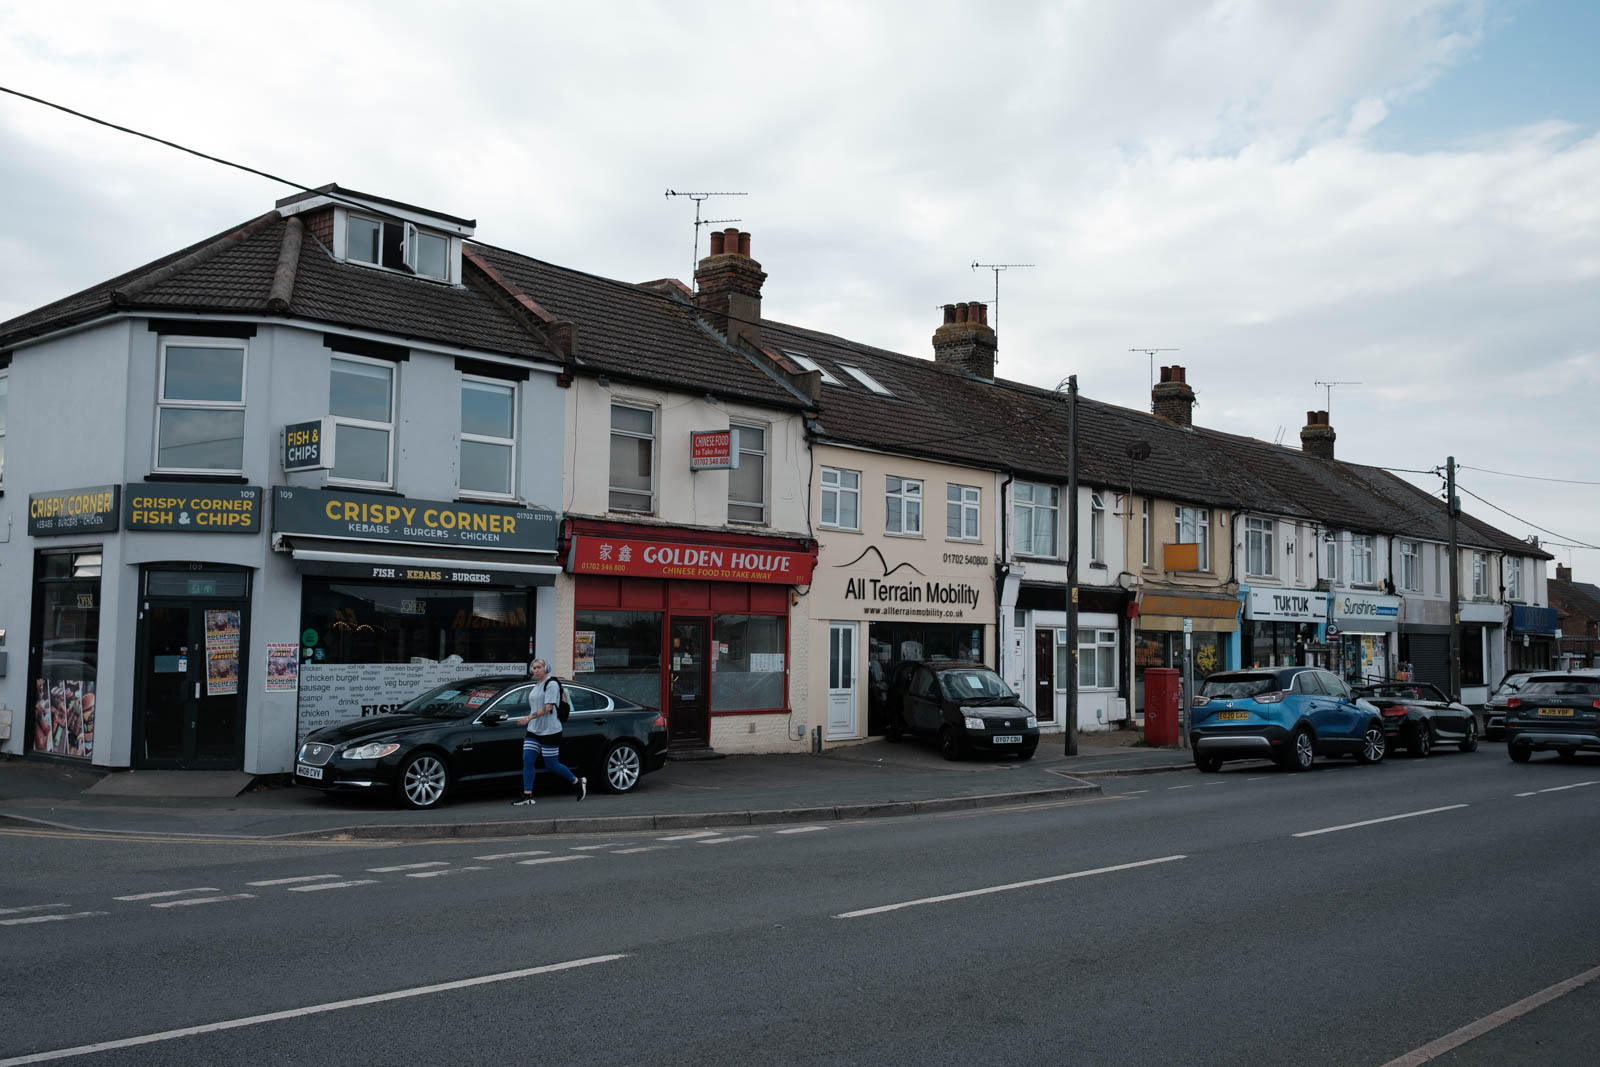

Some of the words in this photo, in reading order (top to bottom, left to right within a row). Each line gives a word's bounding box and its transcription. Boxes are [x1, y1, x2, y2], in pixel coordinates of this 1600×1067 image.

[288, 430, 309, 446] FISH
[312, 429, 319, 443] &
[696, 436, 715, 447] CHINESE
[715, 435, 728, 446] FOOD
[288, 445, 317, 461] CHIPS
[714, 448, 728, 456] Away
[280, 491, 293, 499] 109
[31, 496, 65, 518] CRISPY
[67, 492, 112, 516] CORNER
[132, 497, 186, 509] CRISPY
[190, 499, 253, 511] CORNER
[132, 510, 173, 524] FISH
[178, 512, 191, 525] &
[196, 512, 251, 526] CHIPS
[325, 500, 416, 526] CRISPY
[423, 509, 516, 534] CORNER
[516, 512, 534, 520] 01702
[348, 523, 390, 534] KEBABS
[403, 527, 449, 538] BURGERS
[460, 531, 500, 542] CHICKEN
[643, 546, 723, 568] GOLDEN
[731, 552, 792, 572] HOUSE
[943, 553, 964, 564] 01702
[965, 555, 988, 566] 540800
[581, 562, 600, 570] 01702
[614, 564, 626, 572] 800
[662, 566, 695, 576] CHINESE
[697, 568, 719, 577] FOOD
[721, 569, 730, 577] TO
[731, 570, 751, 579] TAKE
[751, 571, 772, 580] AWAY
[372, 568, 395, 578] FISH
[407, 570, 441, 580] KEBABS
[452, 572, 491, 583] BURGERS
[845, 578, 865, 600] All
[870, 579, 921, 602] Terrain
[927, 582, 979, 610] Mobility
[863, 606, 964, 618] www.allterrainmobility.co.uk
[1344, 597, 1376, 615] Sunshine
[512, 664, 525, 672] rings
[306, 674, 334, 682] chicken
[336, 674, 360, 683] burger
[385, 680, 397, 688] veg
[398, 680, 420, 688] burger
[299, 694, 322, 702] scampi
[338, 698, 359, 706] drinks
